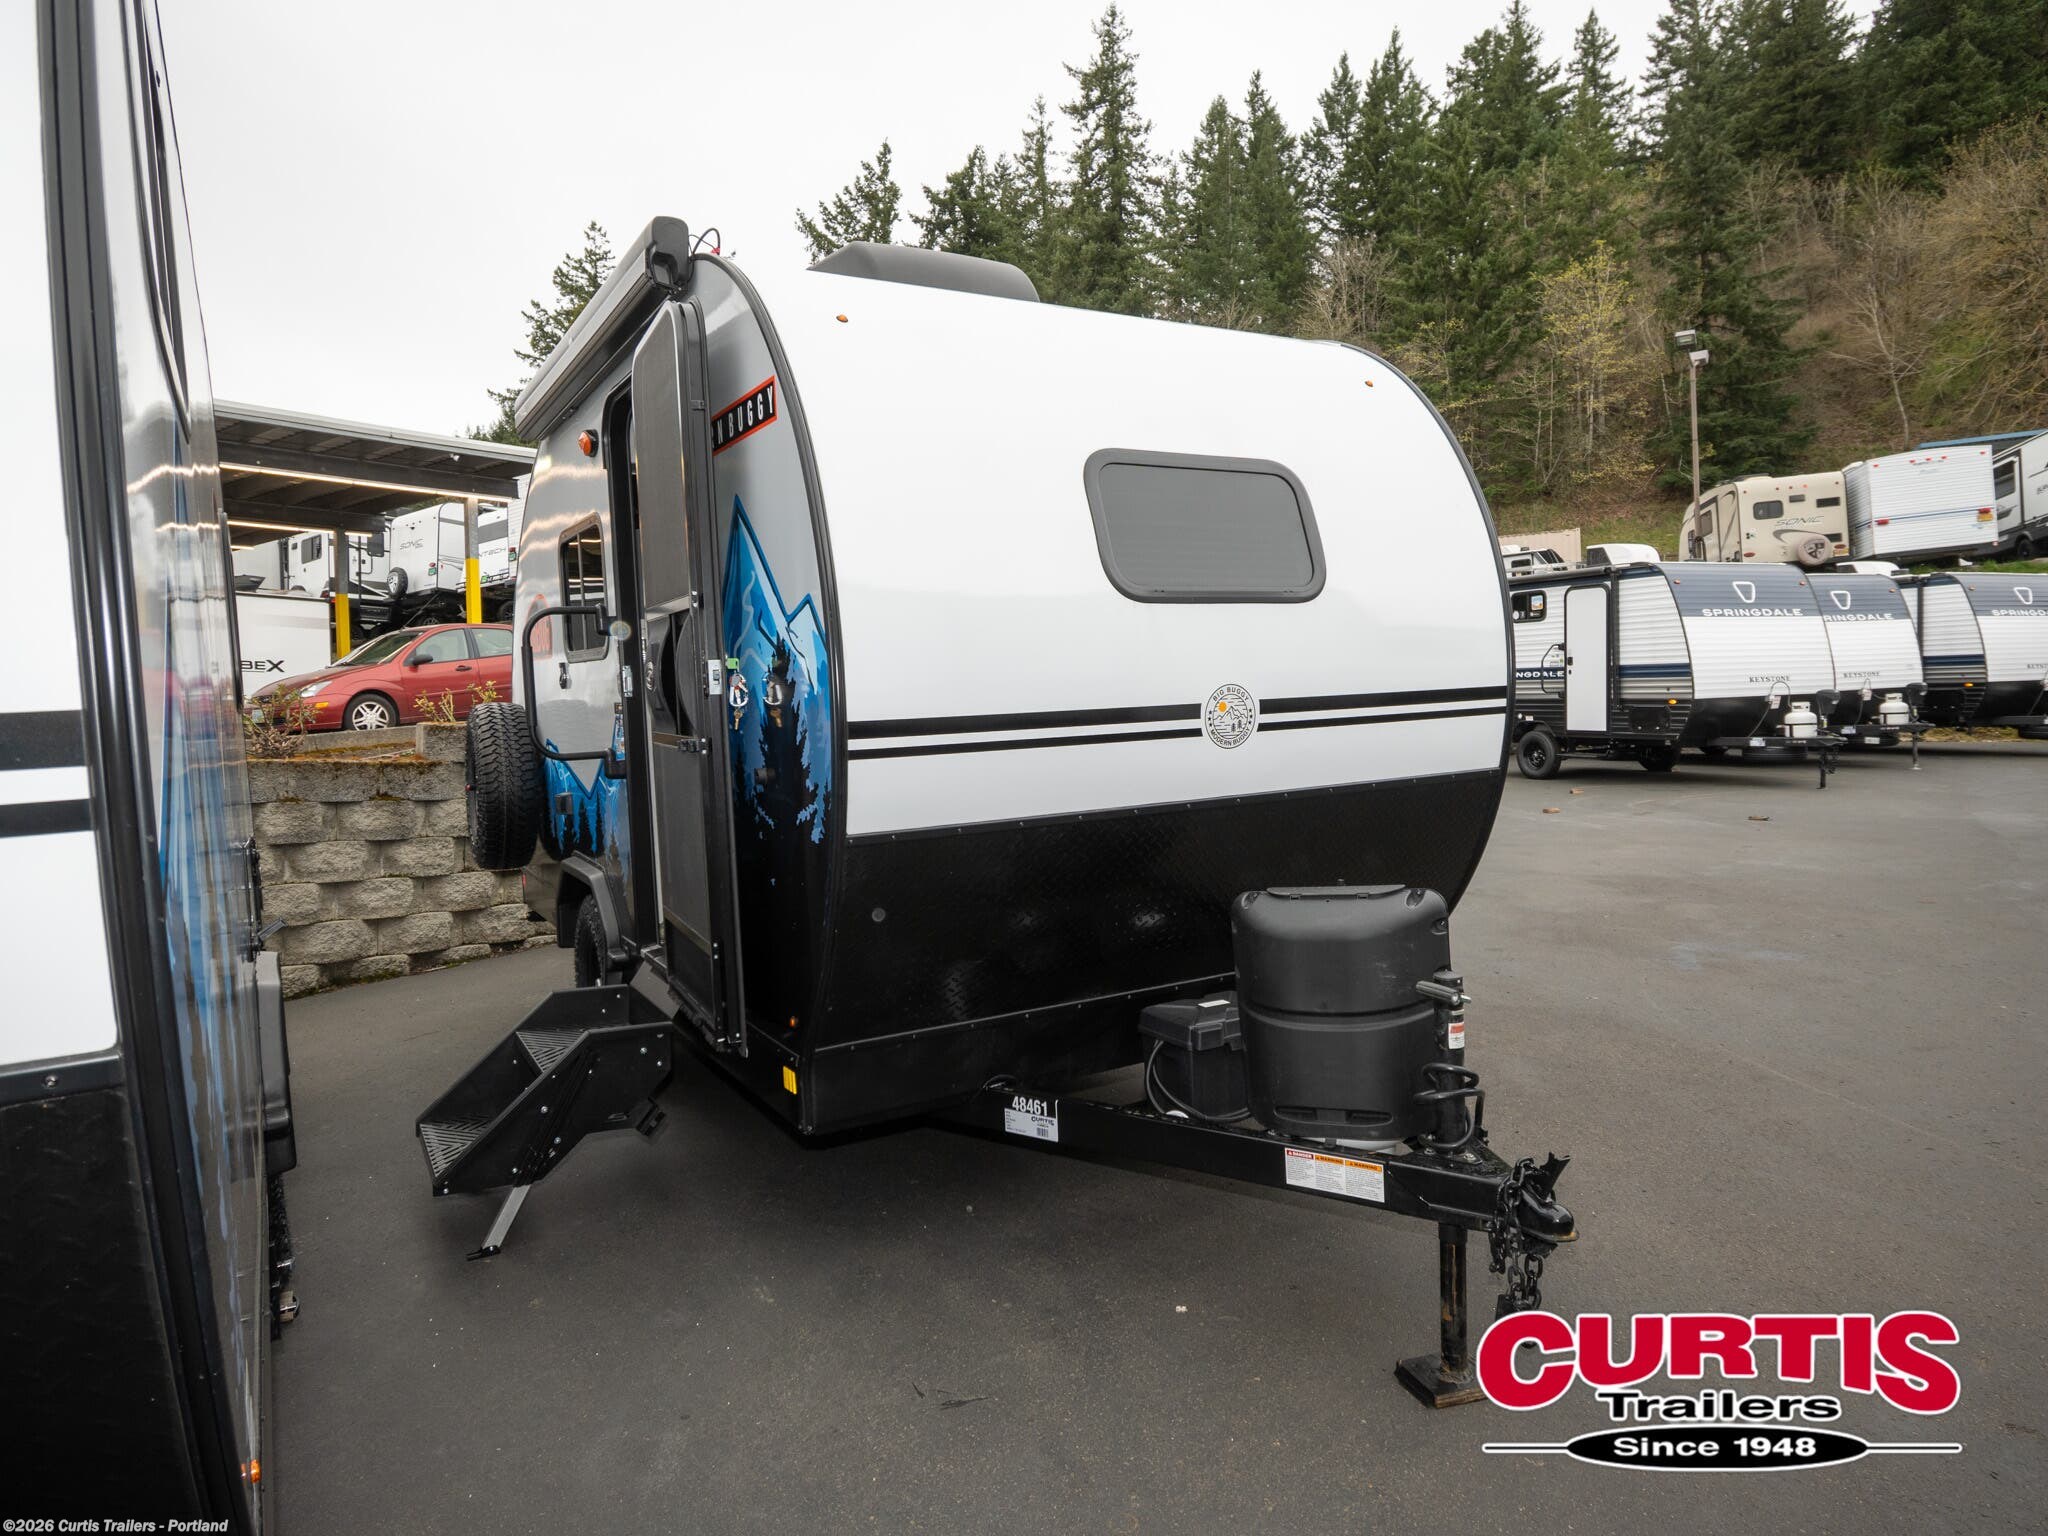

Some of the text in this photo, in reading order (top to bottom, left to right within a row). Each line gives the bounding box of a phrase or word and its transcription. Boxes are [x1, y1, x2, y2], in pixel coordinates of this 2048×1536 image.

[728, 386, 773, 437] BUGGY
[1775, 515, 1825, 527] SONIC
[1702, 608, 1803, 617] SPRINGDALE
[1823, 613, 1894, 622] RINGDALE
[240, 659, 285, 673] BEX
[1749, 675, 1791, 683] KEYSTONE
[1213, 687, 1249, 701] BIG BUGGY
[1211, 728, 1232, 747] MODERN
[1012, 1095, 1048, 1117] 48461
